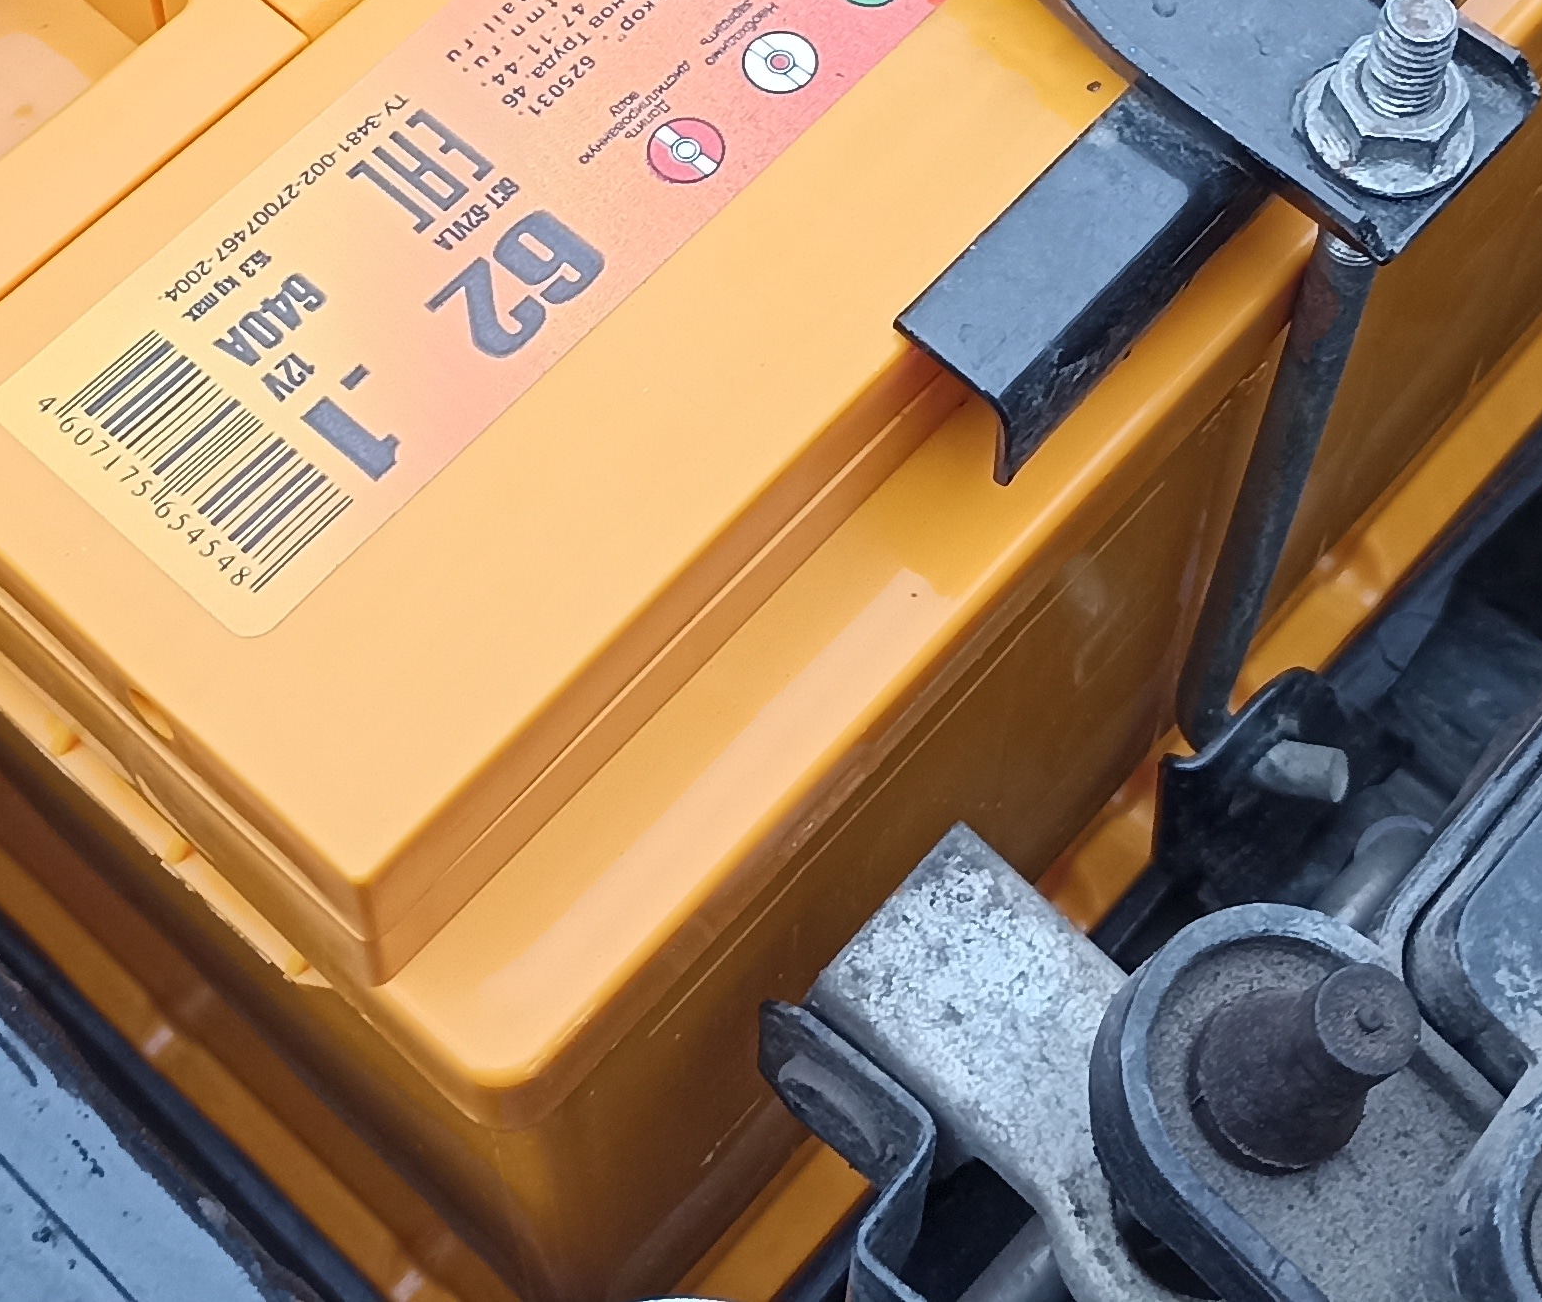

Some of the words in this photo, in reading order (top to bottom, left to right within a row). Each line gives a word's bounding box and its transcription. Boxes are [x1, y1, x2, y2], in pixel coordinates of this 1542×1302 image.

[500, 84, 527, 109] 46
[211, 274, 242, 297] kg
[211, 271, 327, 367] 640A
[422, 208, 606, 359] 62
[260, 351, 316, 403] 12V
[37, 396, 57, 413] 4
[58, 415, 154, 497] 607175
[153, 500, 252, 587] 654548
